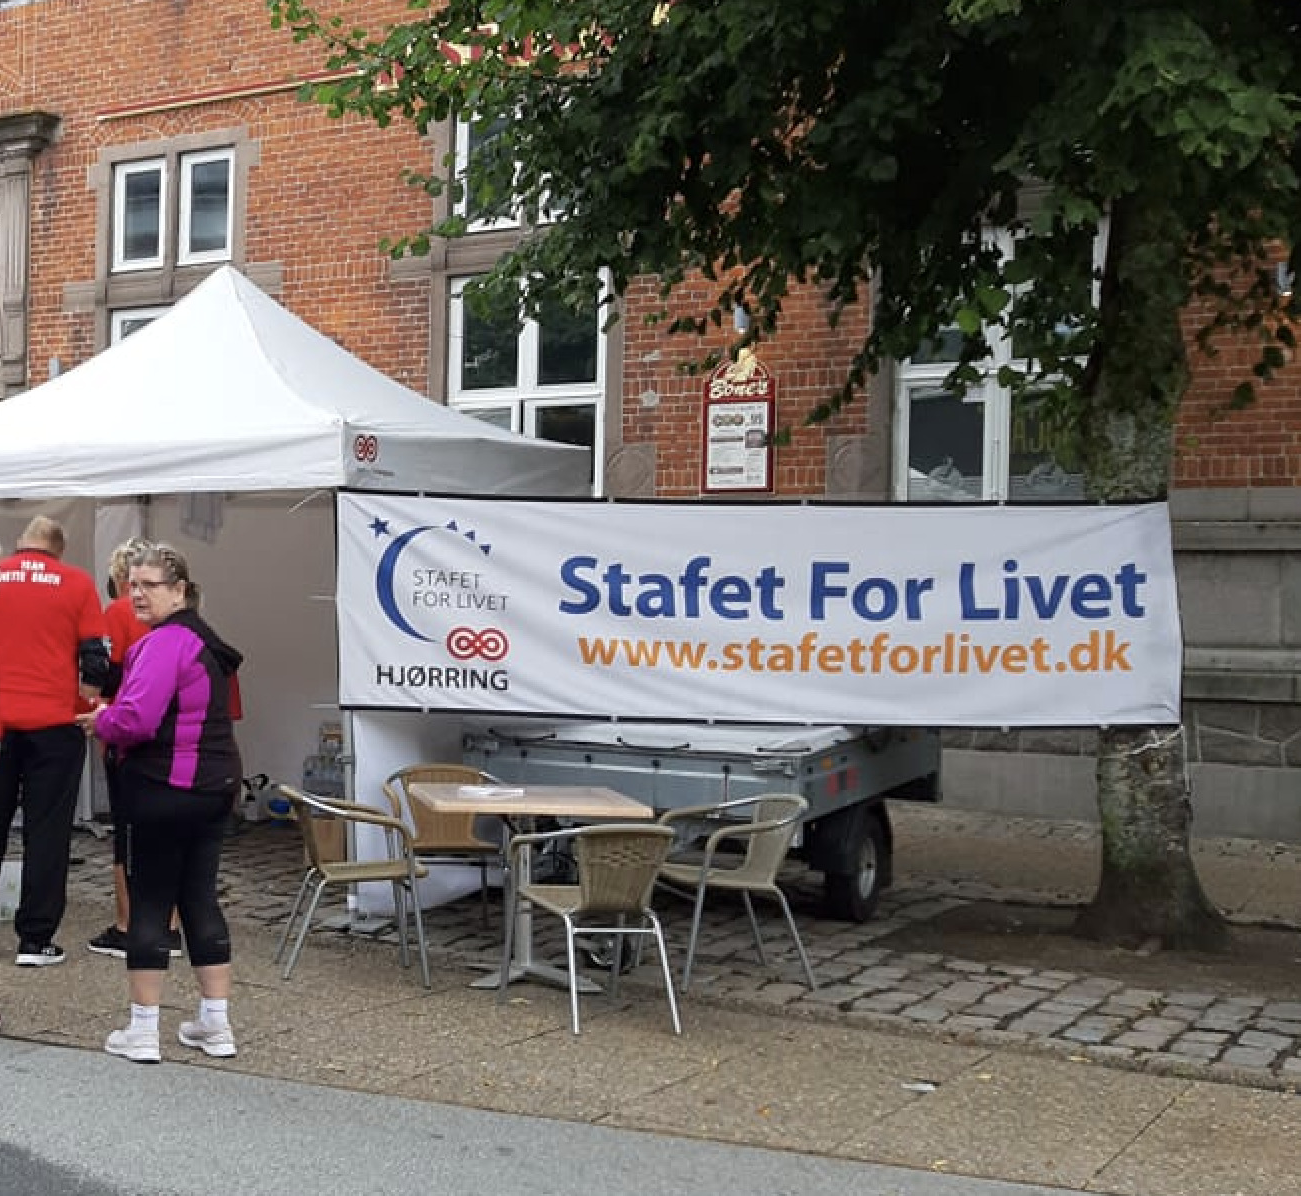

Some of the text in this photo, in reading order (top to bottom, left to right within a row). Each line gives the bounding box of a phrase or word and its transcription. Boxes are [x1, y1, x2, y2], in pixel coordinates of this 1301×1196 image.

[412, 569, 481, 589] STAFET
[559, 556, 1147, 621] Stafet For Livet
[412, 591, 509, 612] FOR LIVET
[578, 630, 1132, 675] www.stafetforlivet.dk
[376, 664, 508, 692] HJØRRING
